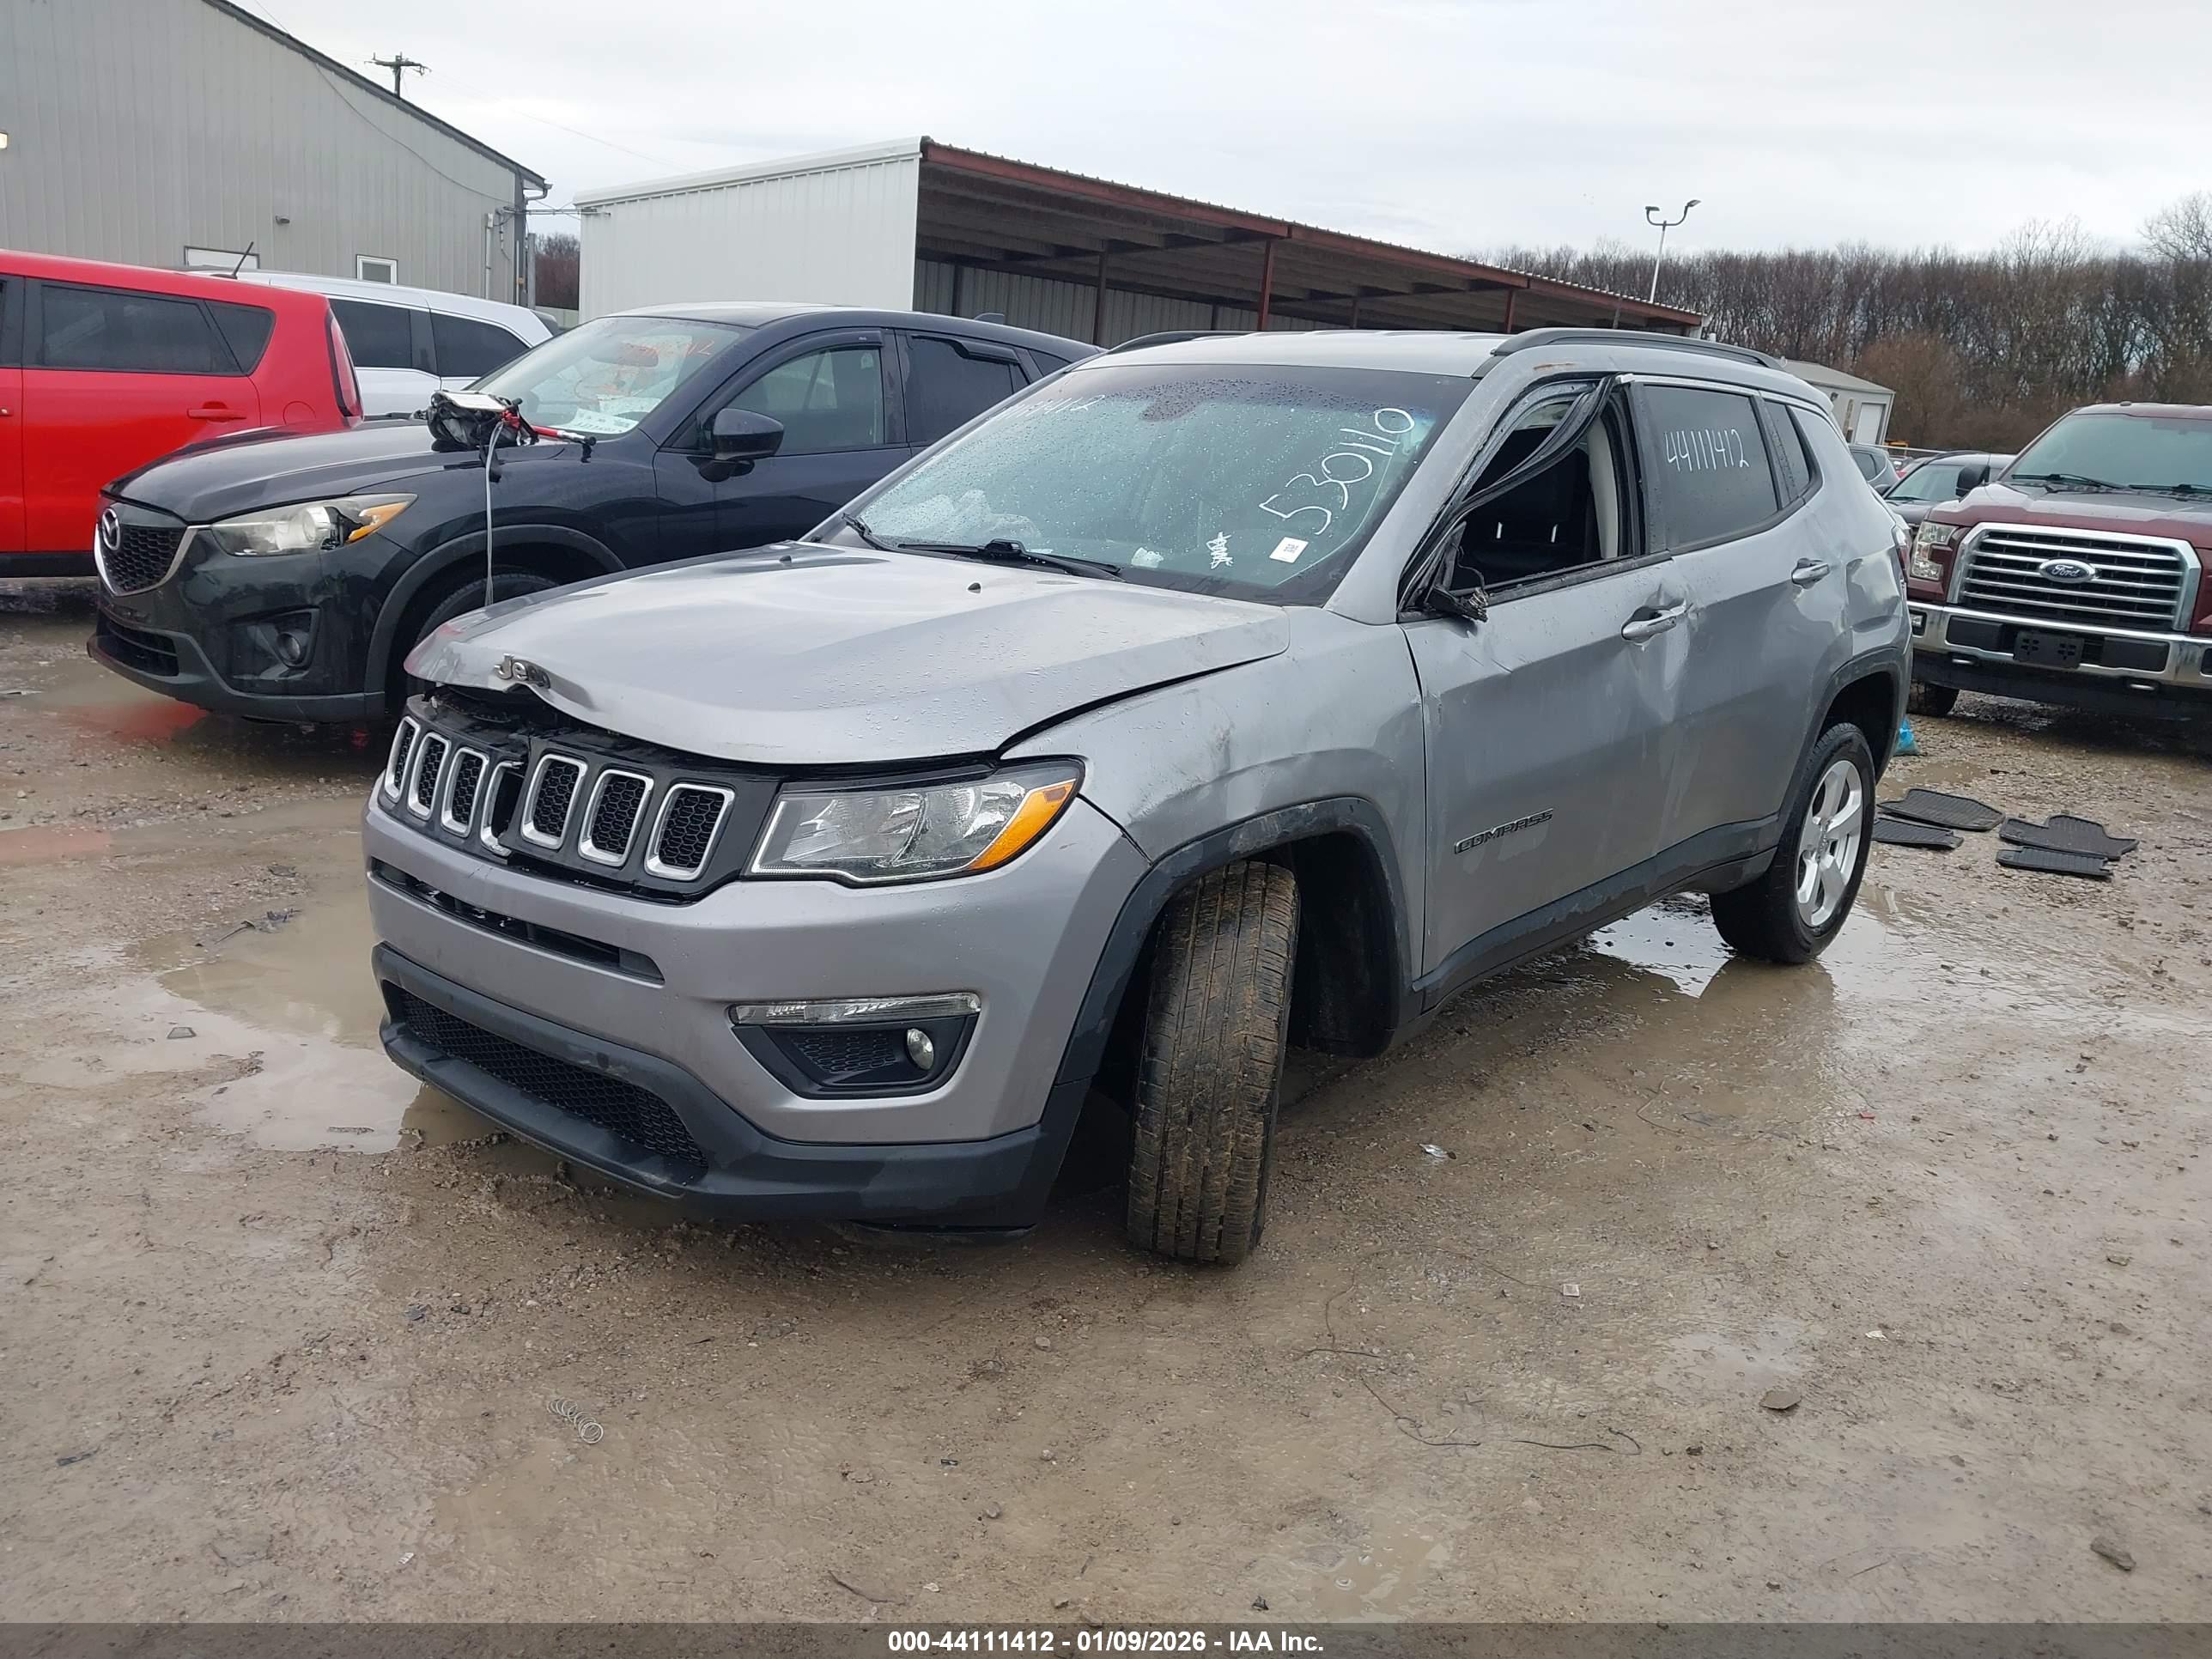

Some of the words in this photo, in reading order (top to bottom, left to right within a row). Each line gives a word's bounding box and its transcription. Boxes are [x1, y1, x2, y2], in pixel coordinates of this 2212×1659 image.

[1258, 408, 1415, 535] 530110
[1664, 428, 1750, 472] 44111412
[2051, 564, 2081, 577] Ford
[494, 653, 551, 689] Jeep
[1454, 807, 1553, 854] COMPASS
